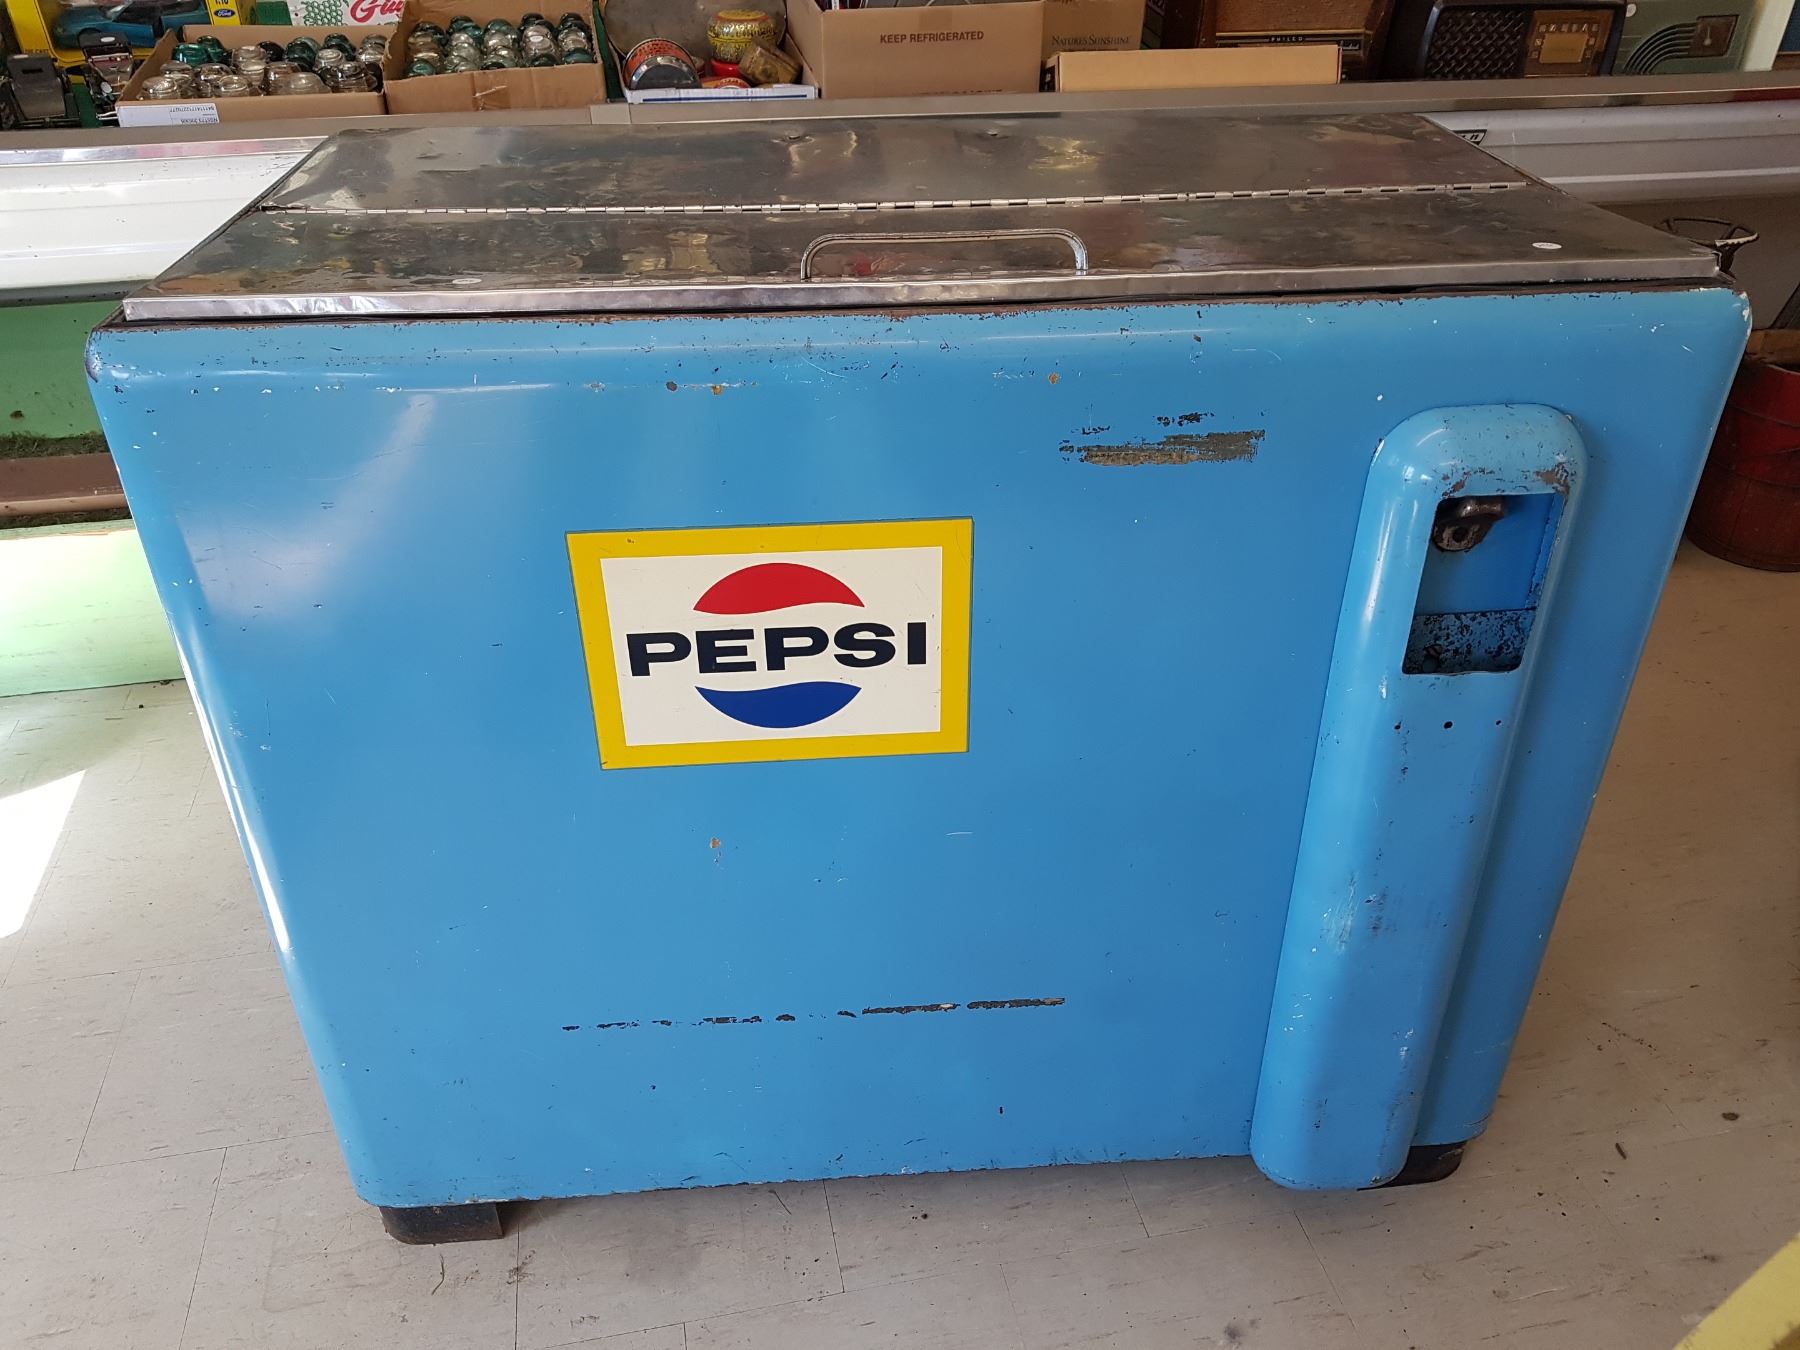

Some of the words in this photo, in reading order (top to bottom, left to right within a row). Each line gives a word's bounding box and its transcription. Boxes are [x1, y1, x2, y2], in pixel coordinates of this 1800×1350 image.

[880, 33, 907, 44] KEEP
[909, 30, 985, 43] REFRIGERATED
[626, 621, 927, 677] PEPSI
